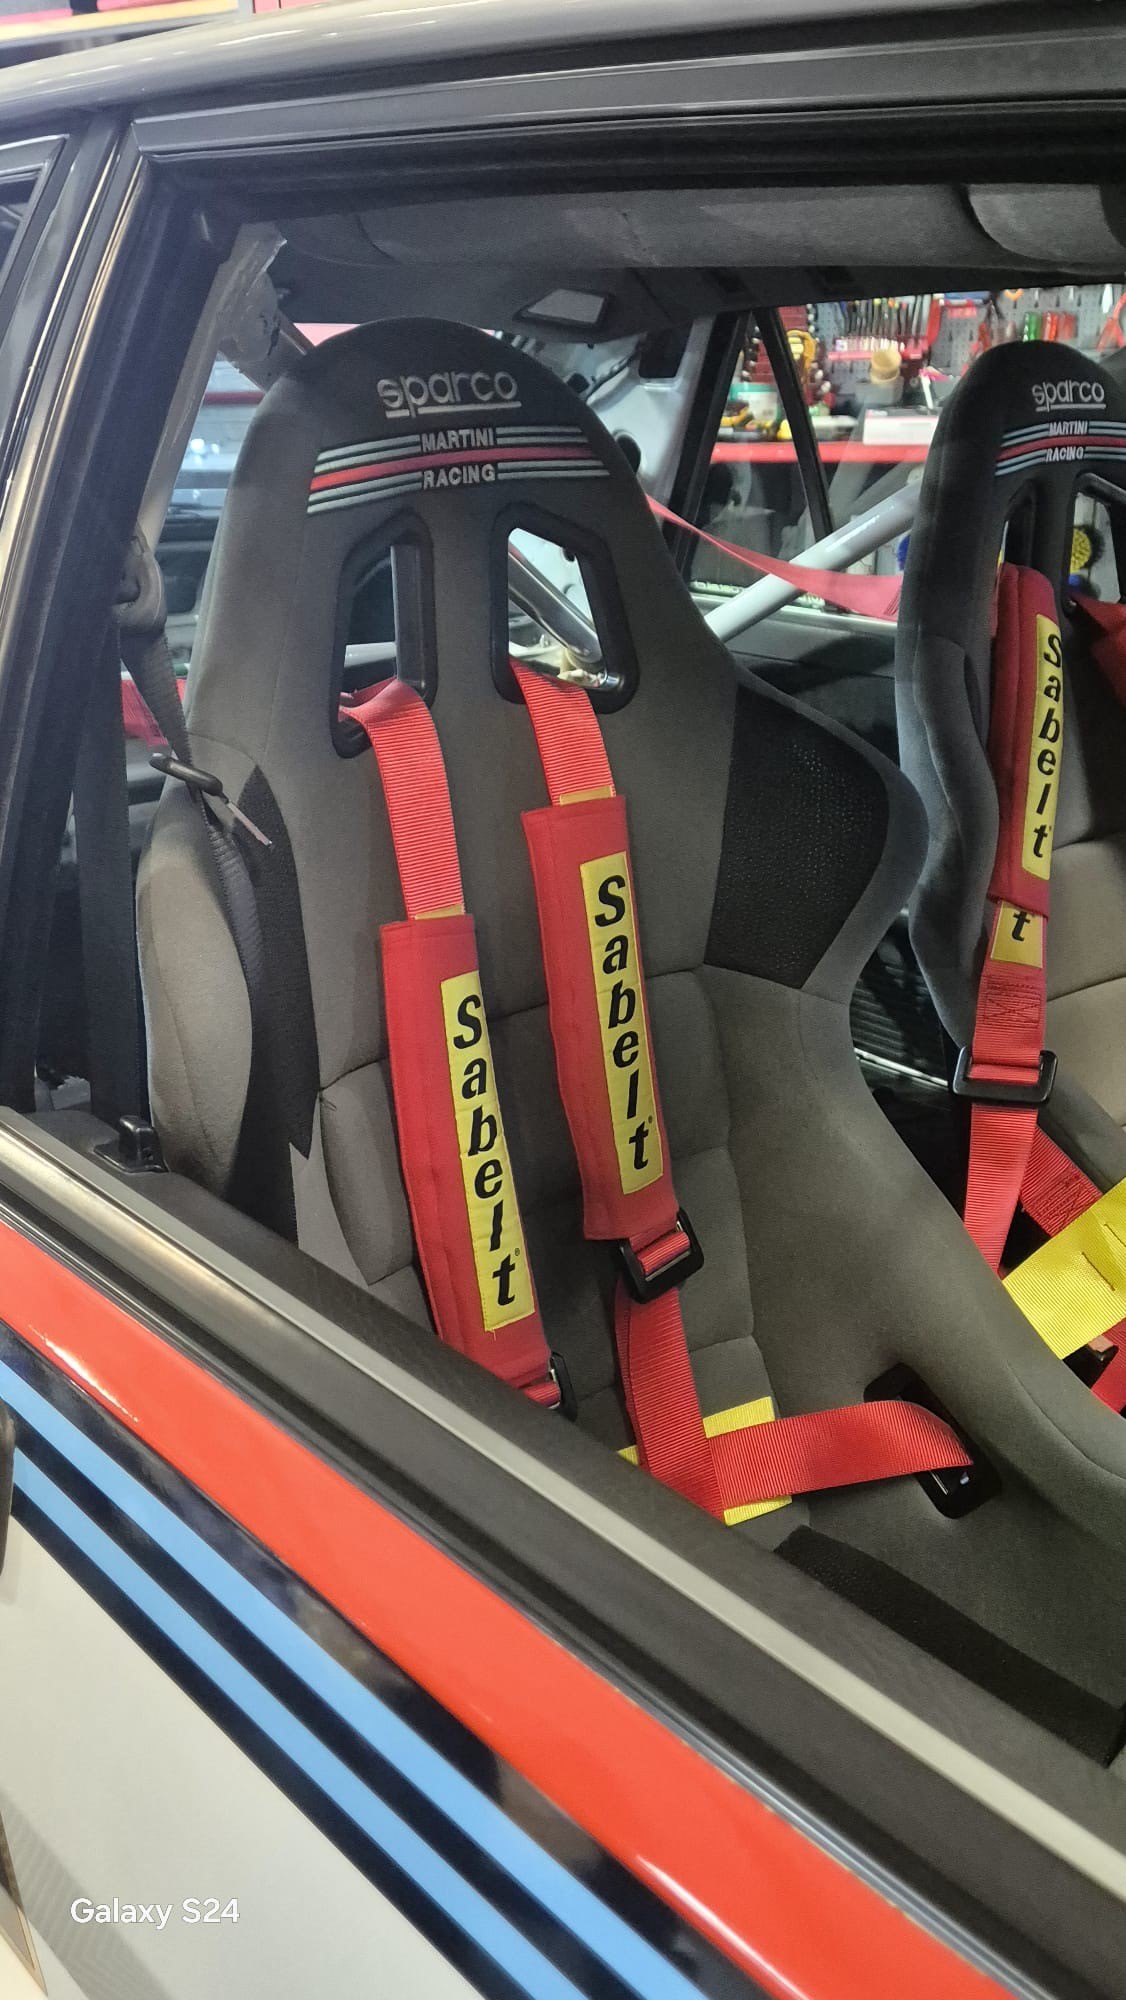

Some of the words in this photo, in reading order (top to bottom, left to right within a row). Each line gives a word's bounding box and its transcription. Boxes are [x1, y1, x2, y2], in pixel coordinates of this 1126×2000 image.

[377, 369, 518, 418] sparco
[1031, 380, 1105, 412] sparco
[420, 426, 496, 453] MARTINI
[1049, 420, 1088, 436] MARTINI
[1045, 446, 1084, 463] RACING
[422, 462, 497, 490] RACING
